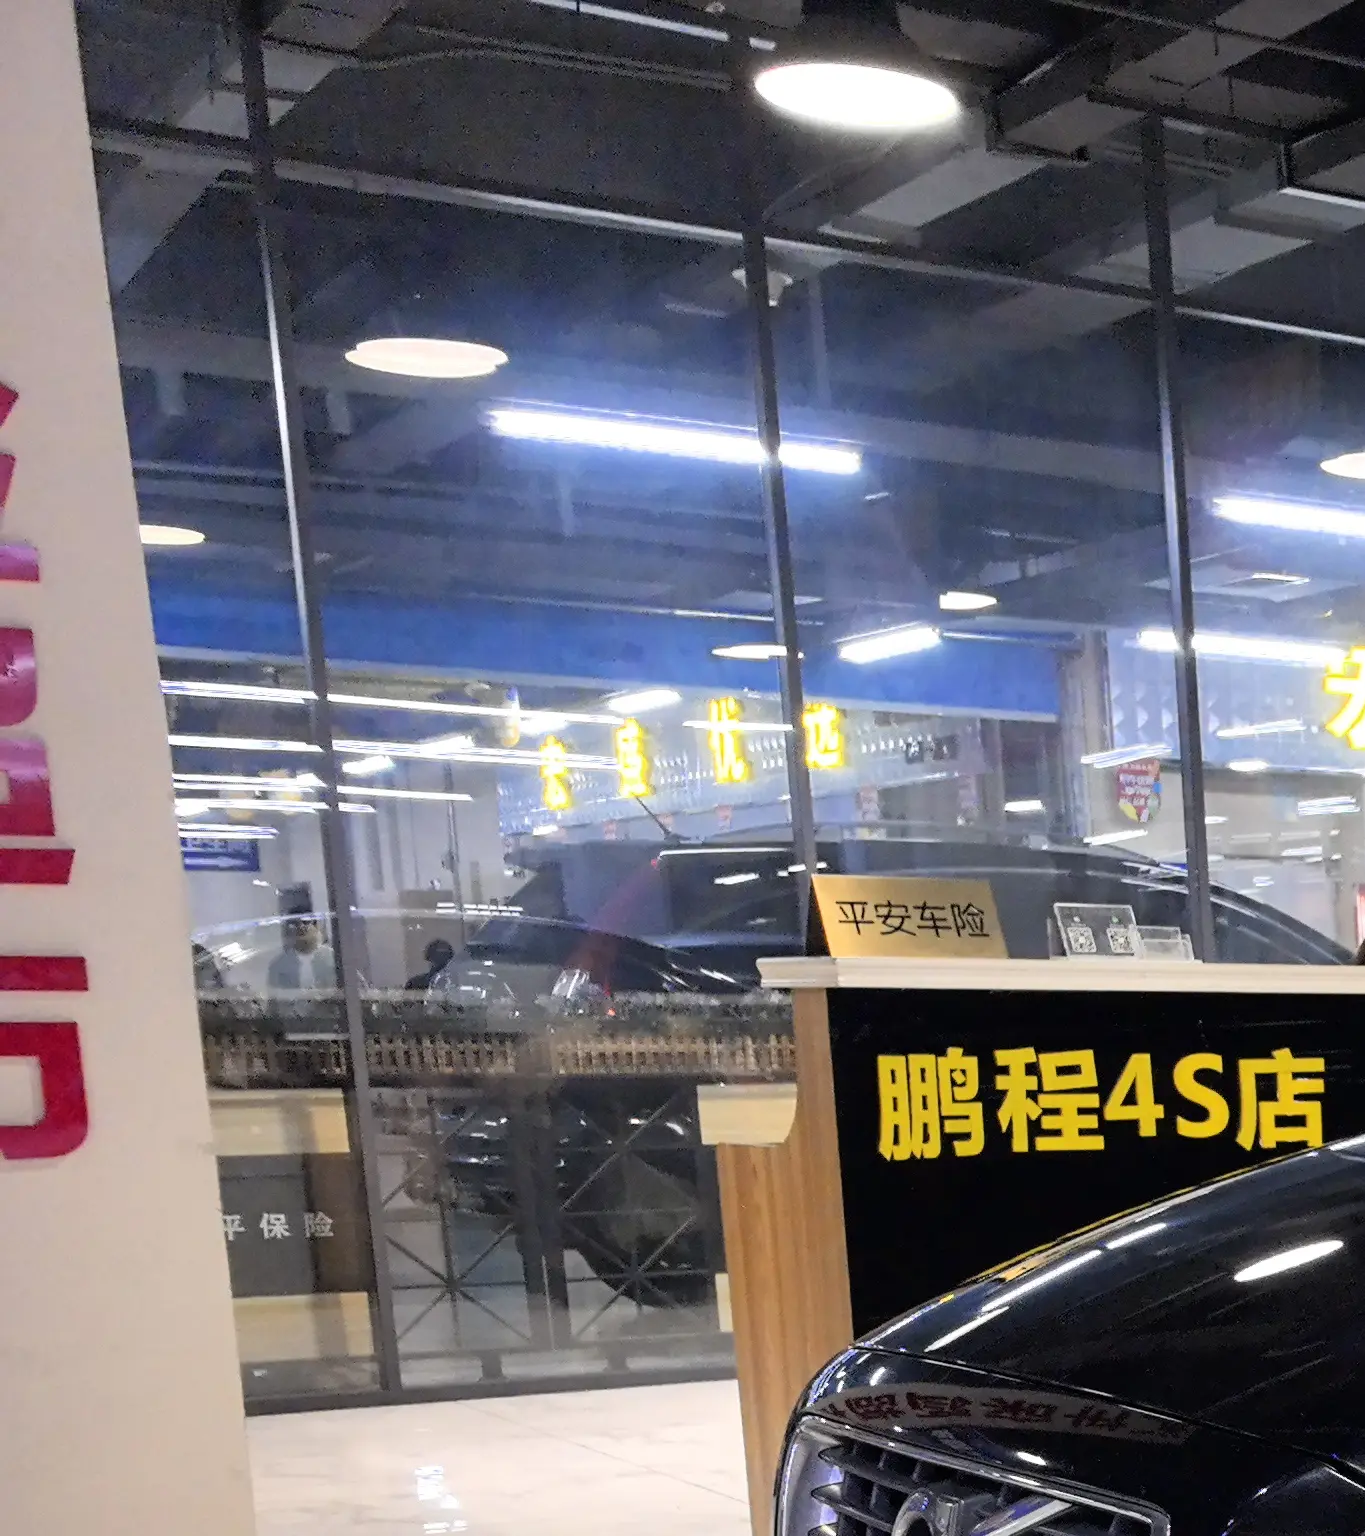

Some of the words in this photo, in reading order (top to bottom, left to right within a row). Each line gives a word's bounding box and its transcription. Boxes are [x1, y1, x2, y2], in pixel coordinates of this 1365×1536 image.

[835, 900, 990, 939] 平安车险
[877, 1047, 1325, 1161] 鹏程4S店
